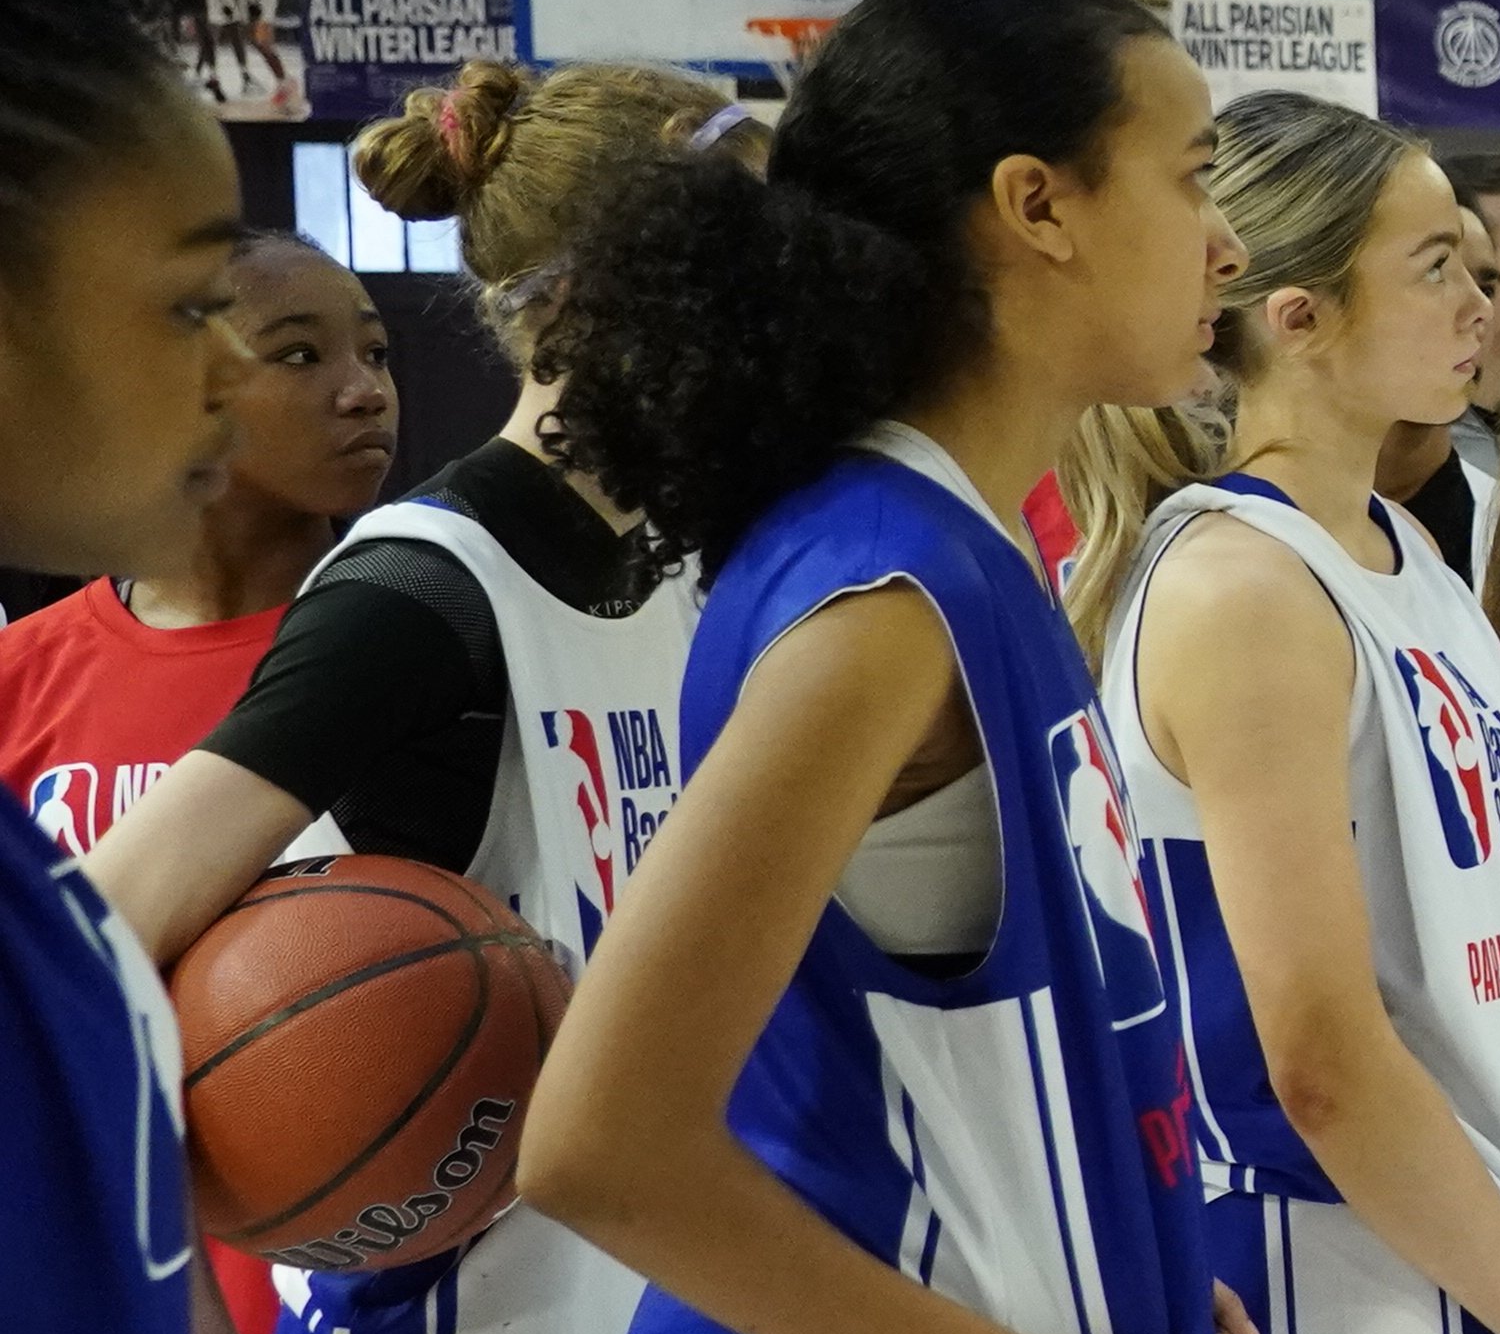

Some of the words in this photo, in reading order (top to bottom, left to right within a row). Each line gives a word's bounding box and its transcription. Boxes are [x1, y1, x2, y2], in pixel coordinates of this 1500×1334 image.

[1183, 3, 1227, 35] ALL
[1230, 6, 1335, 37] PARISIAN
[310, 26, 421, 62] WINTER
[1186, 38, 1277, 70] WINTER
[1279, 41, 1368, 73] LEAGUE
[607, 708, 672, 790] NBA
[260, 1097, 516, 1273] Wilson
